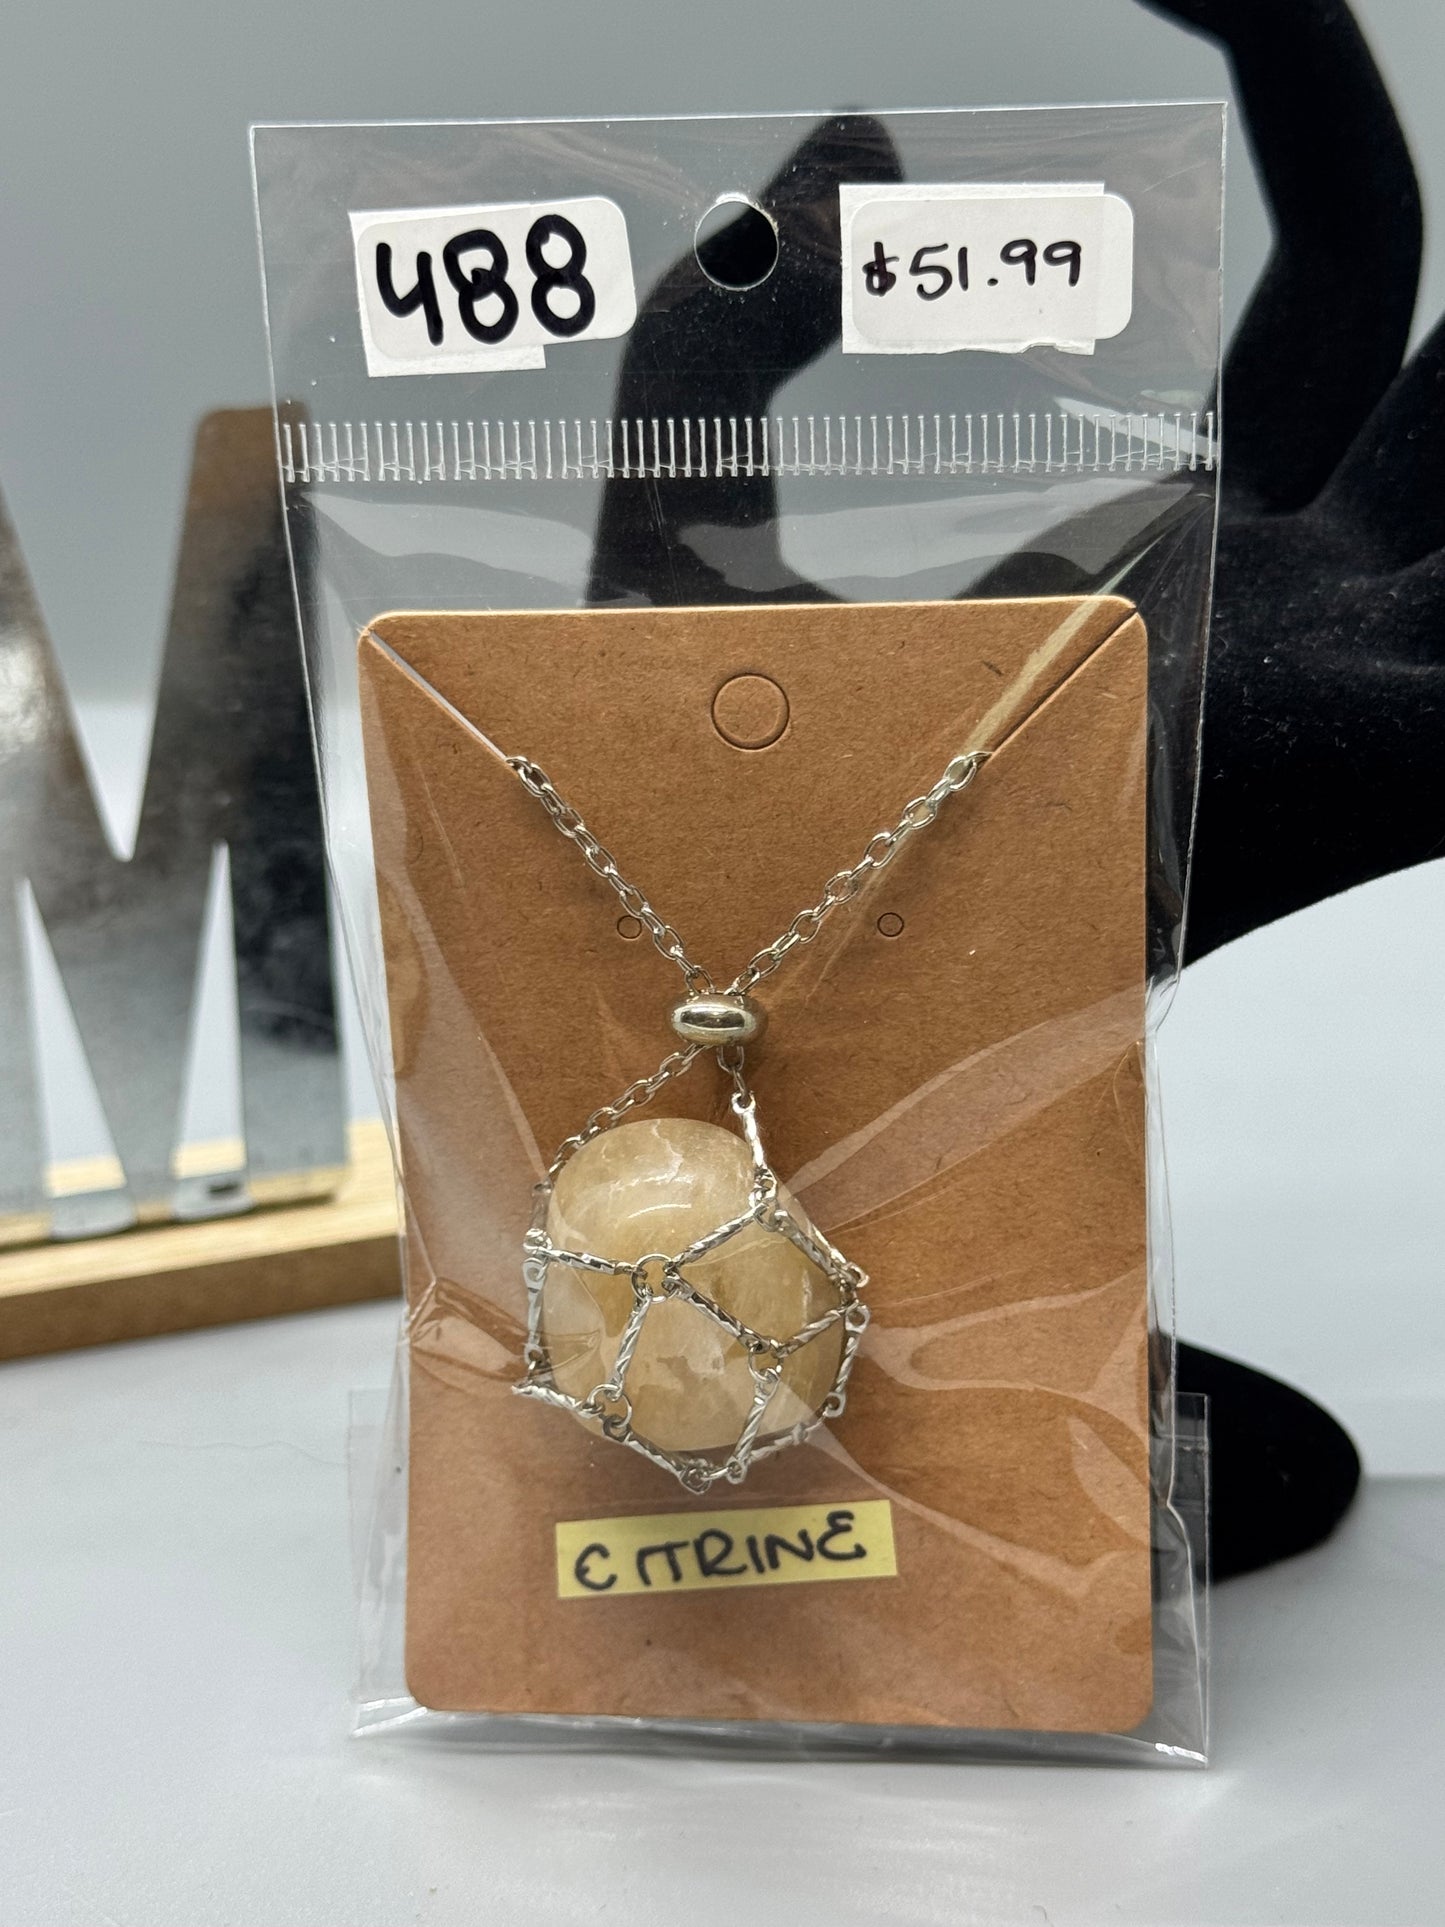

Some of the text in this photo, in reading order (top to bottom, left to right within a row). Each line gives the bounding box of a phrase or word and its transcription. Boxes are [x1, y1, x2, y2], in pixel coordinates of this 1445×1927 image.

[375, 214, 597, 346] 488
[862, 237, 1082, 300] $51.99
[573, 1509, 868, 1592] CITRINE
